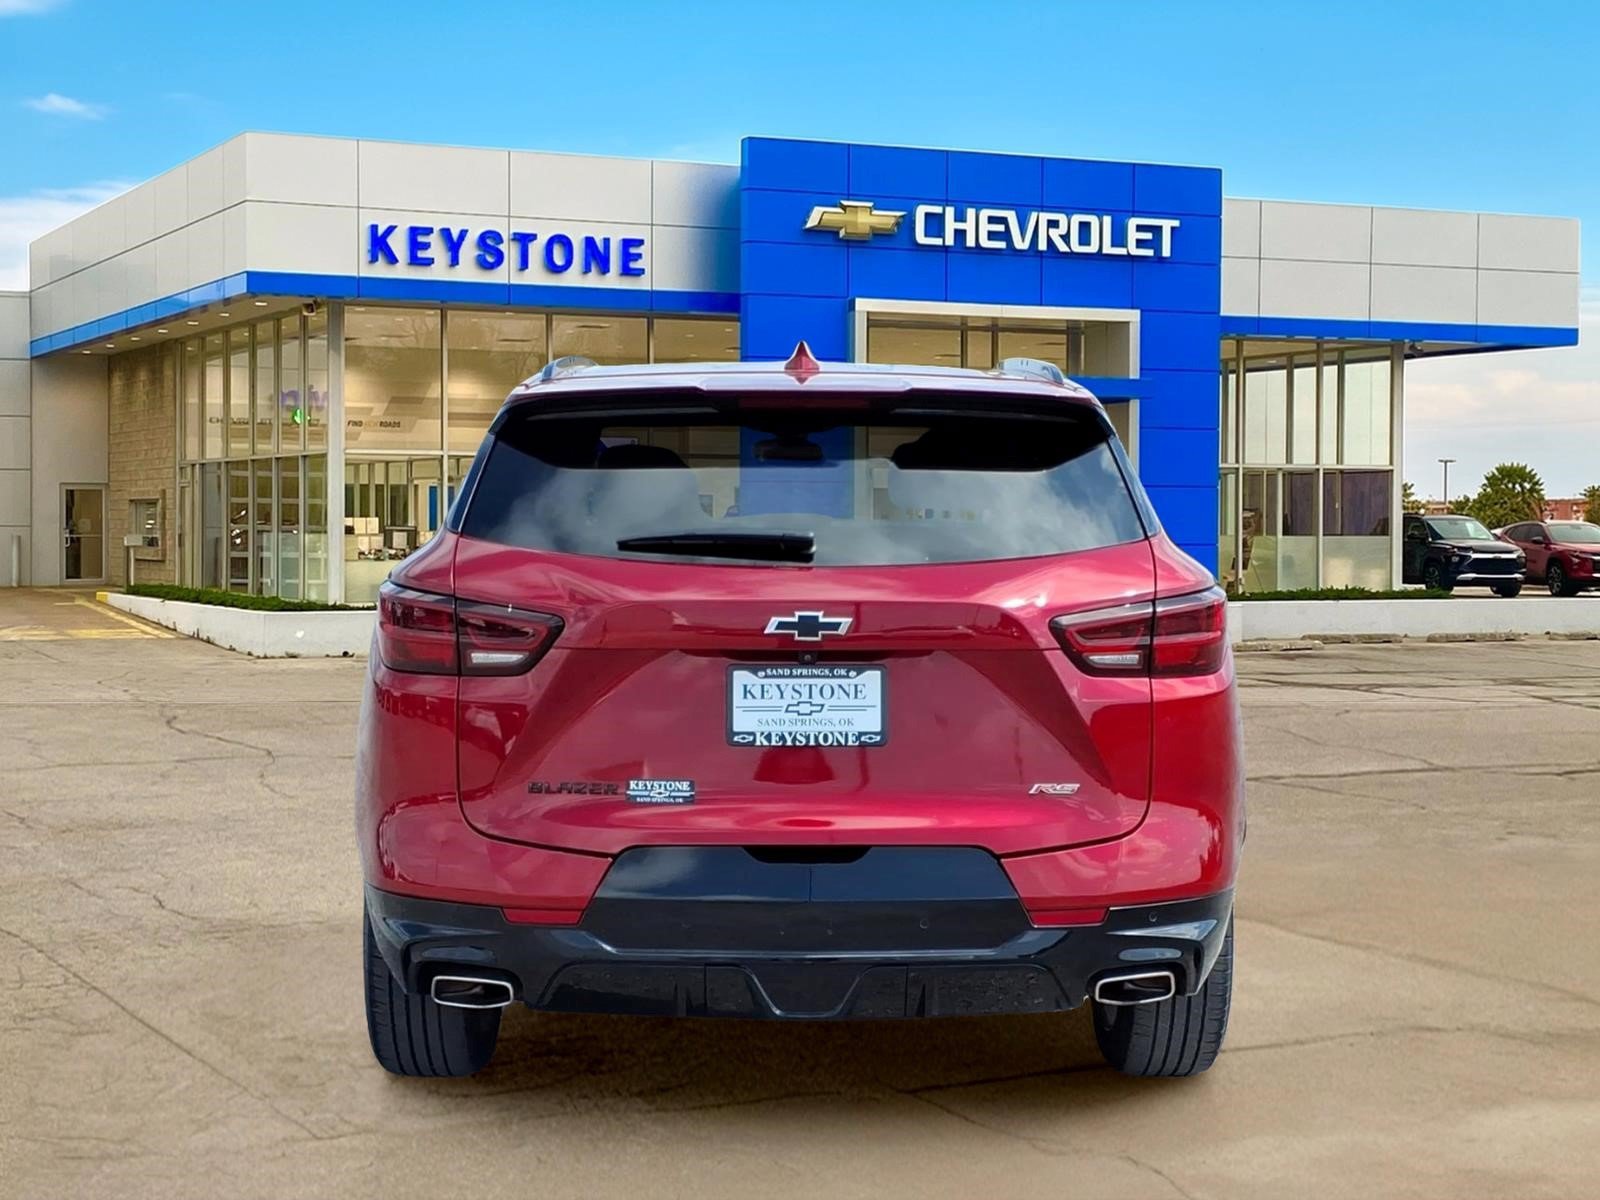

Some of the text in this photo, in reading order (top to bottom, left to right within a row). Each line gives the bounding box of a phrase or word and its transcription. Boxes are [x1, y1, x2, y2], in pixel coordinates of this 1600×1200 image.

[913, 204, 1180, 258] CHEVROLET
[368, 223, 646, 277] KEYSTONE
[766, 667, 848, 677] SAND SPRINGS, OK
[742, 683, 866, 700] KEYSTONE
[757, 718, 854, 728] SAND SPRINGS, OK
[755, 731, 859, 746] KEYSTONE
[527, 782, 619, 796] BLAZER
[629, 780, 690, 791] KEYSTONE
[1028, 783, 1080, 795] RS
